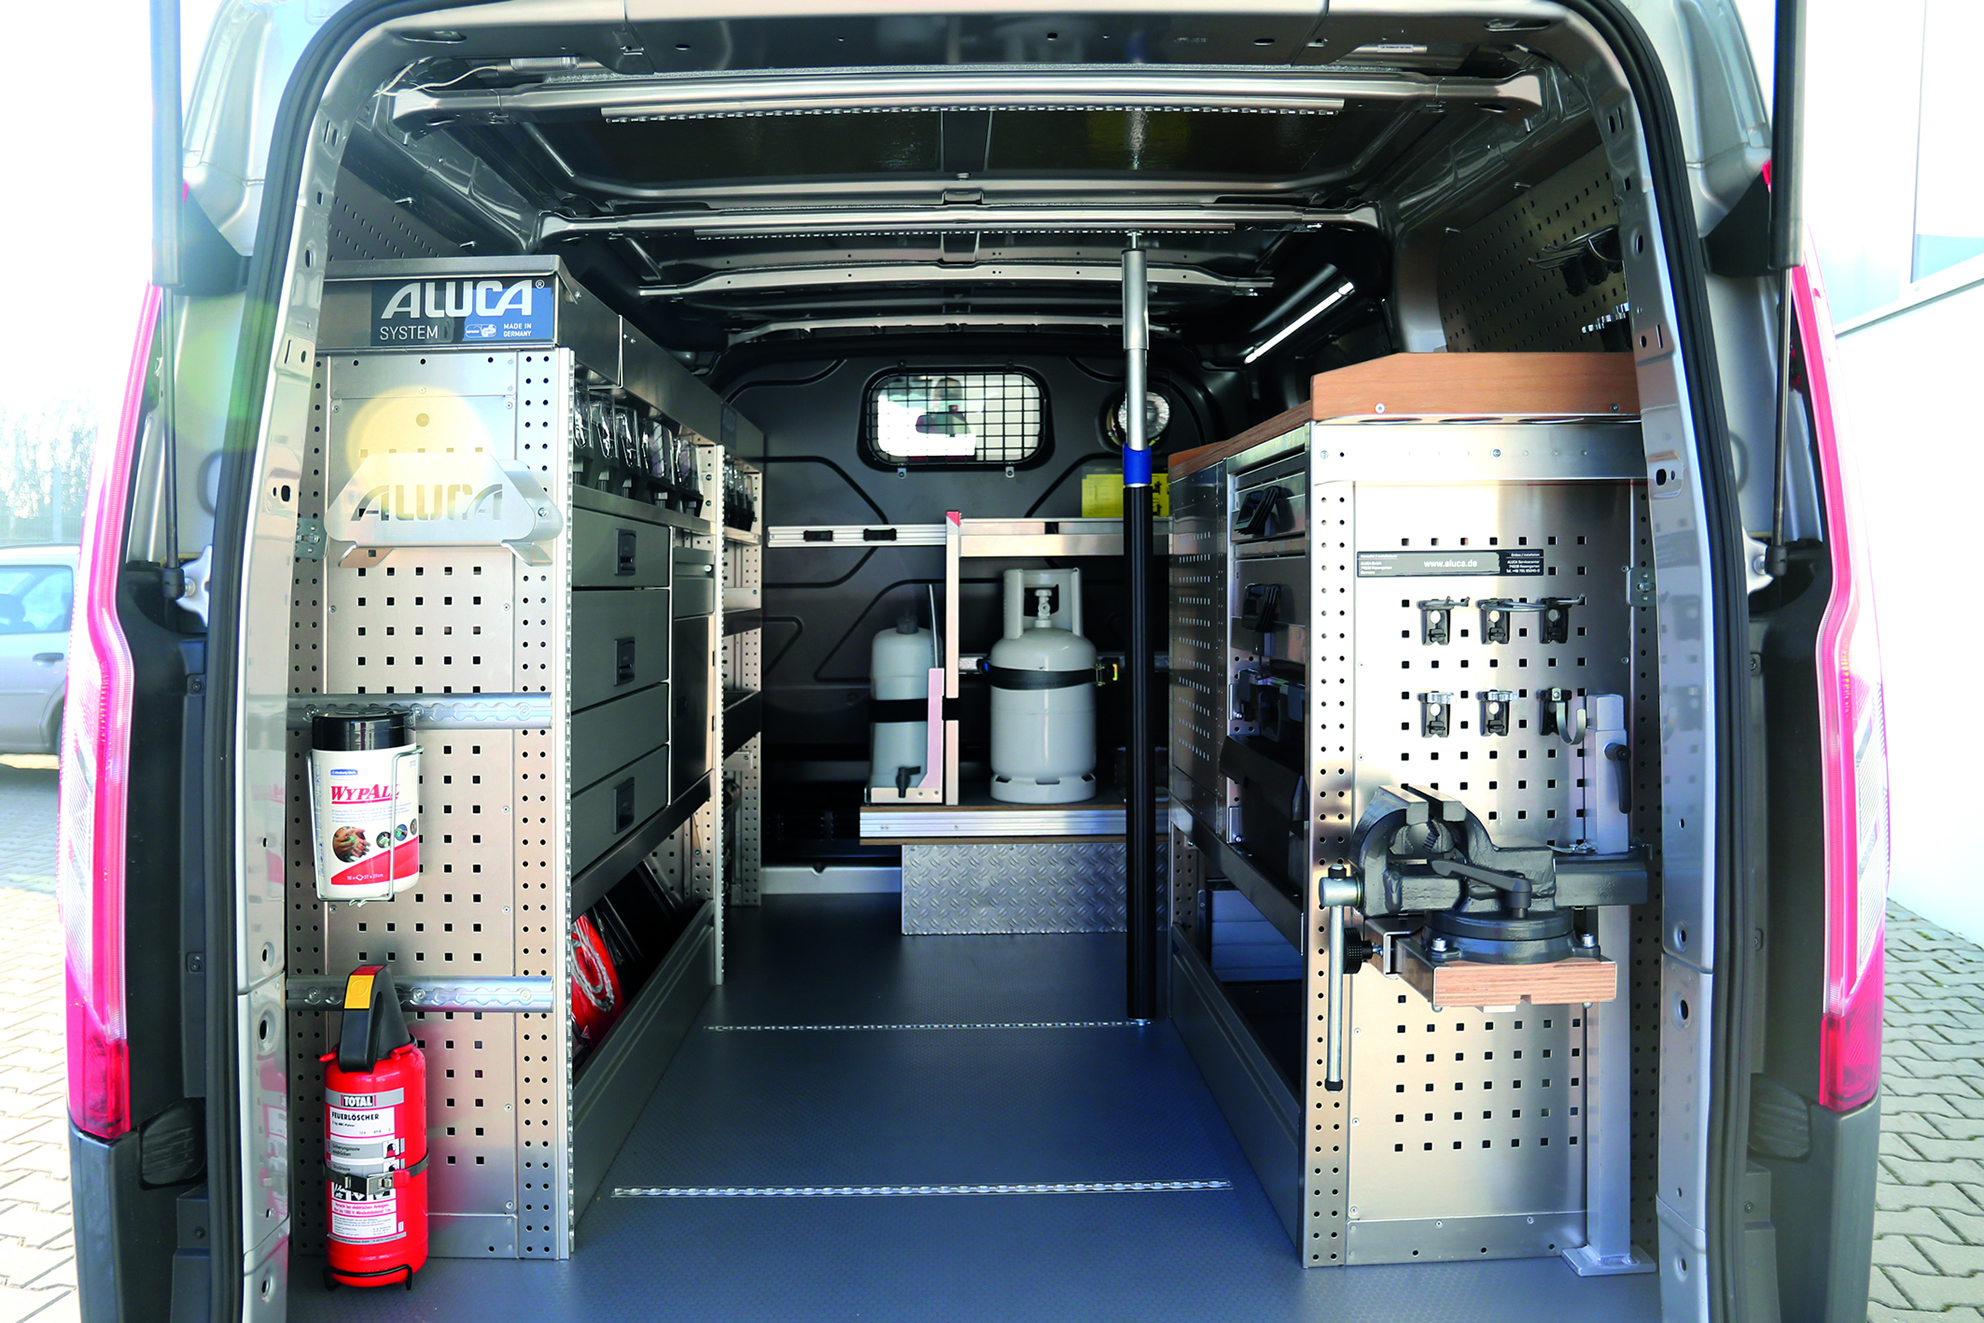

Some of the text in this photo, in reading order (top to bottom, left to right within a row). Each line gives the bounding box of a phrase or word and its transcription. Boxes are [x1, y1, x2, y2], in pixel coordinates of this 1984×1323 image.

[379, 325, 439, 341] SYSTEM
[350, 484, 503, 521] ALUCA
[1423, 559, 1478, 568] www.aluca.de
[344, 1096, 372, 1106] TOTAL
[332, 1112, 379, 1121] FEUERLÖSCHER
